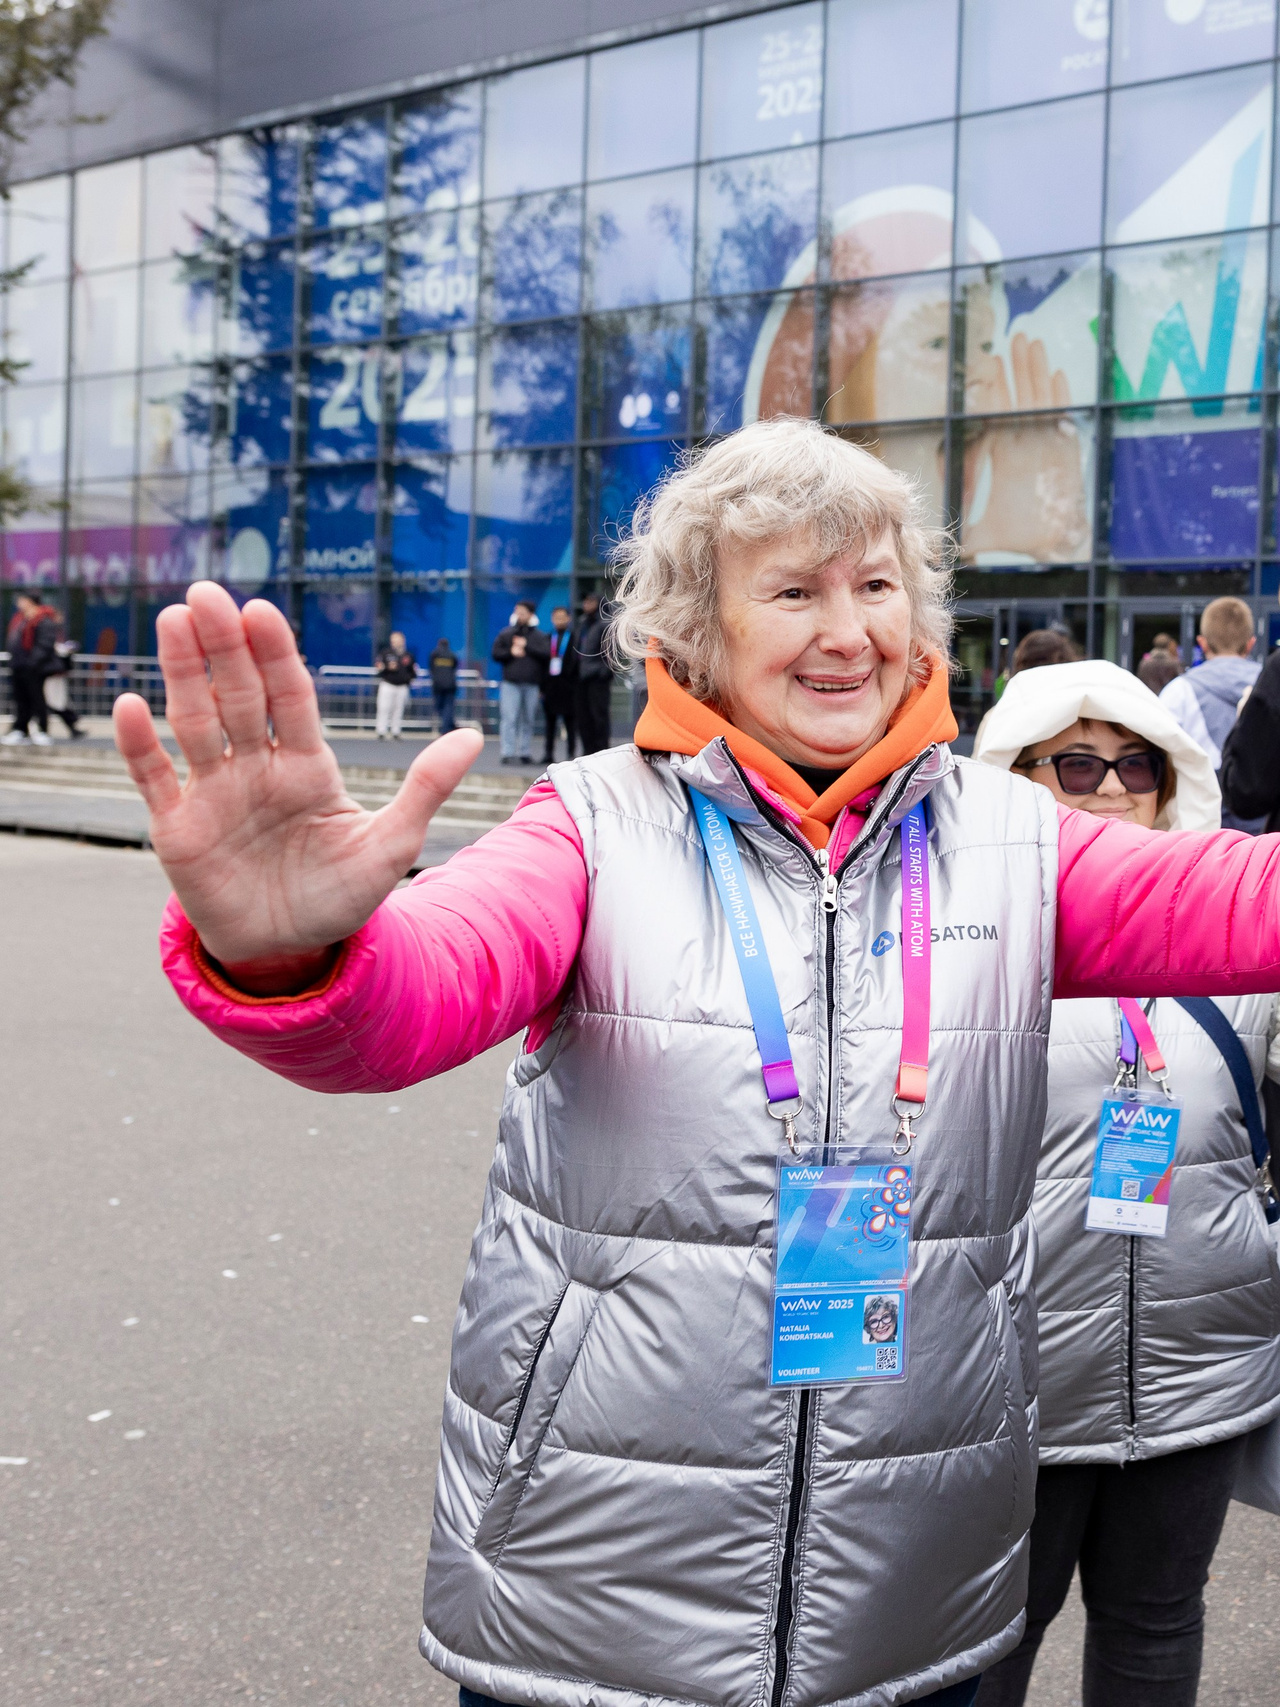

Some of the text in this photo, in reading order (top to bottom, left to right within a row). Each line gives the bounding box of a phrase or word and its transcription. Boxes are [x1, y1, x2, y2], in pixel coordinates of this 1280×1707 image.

[757, 77, 822, 120] 202
[702, 802, 759, 958] ВСЕ НАЧИНАЕТСЯ С АТОМА
[908, 814, 924, 958] IT ALL STARTS WITH ATOM
[899, 925, 999, 947] SATOM
[1110, 1106, 1173, 1129] WAW
[787, 1168, 824, 1181] WAW
[781, 1298, 855, 1312] WAW 2025
[779, 1324, 810, 1333] NATALIA
[778, 1367, 820, 1376] VOLUNTEER
